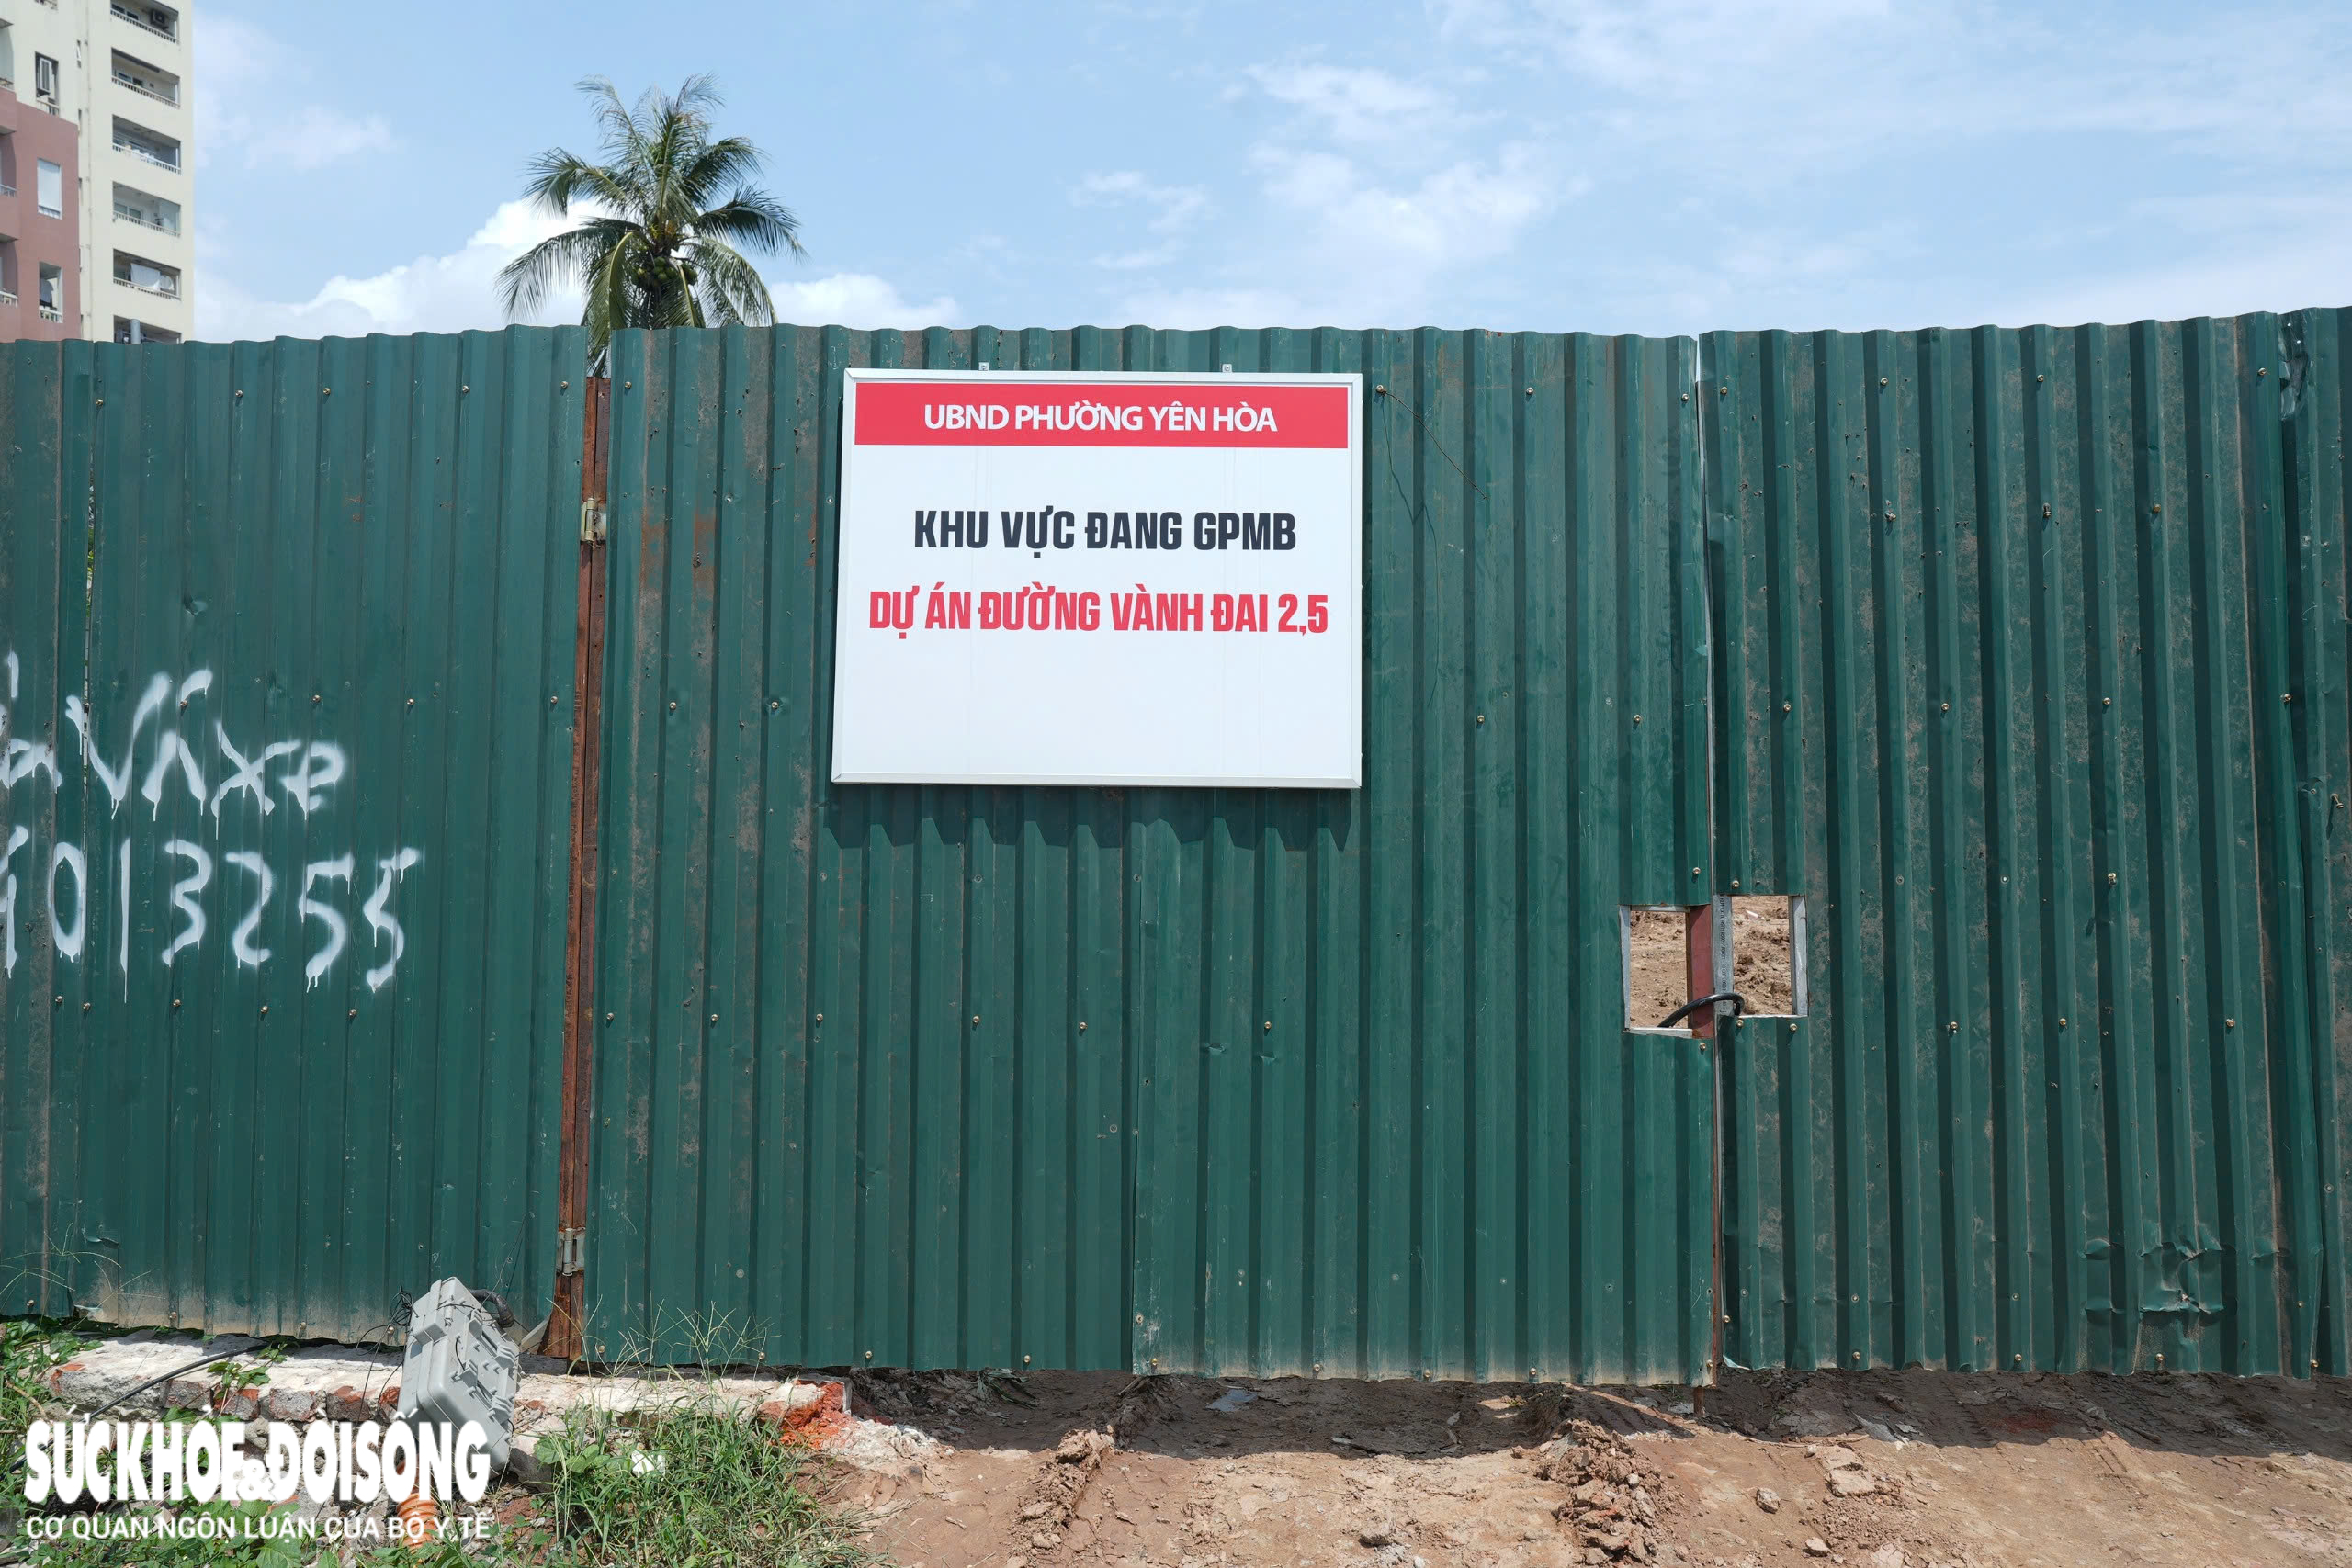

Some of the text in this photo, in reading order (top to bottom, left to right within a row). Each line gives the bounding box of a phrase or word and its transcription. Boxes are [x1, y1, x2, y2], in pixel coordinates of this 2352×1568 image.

[924, 400, 1278, 433] UBND PHƯỜNG YÊN HÒA
[914, 505, 1296, 559] KHU VỰC ĐANG GPMB
[869, 581, 1329, 640] DỰ ÁN ĐƯỜNG VÀNH ĐAI 2,5
